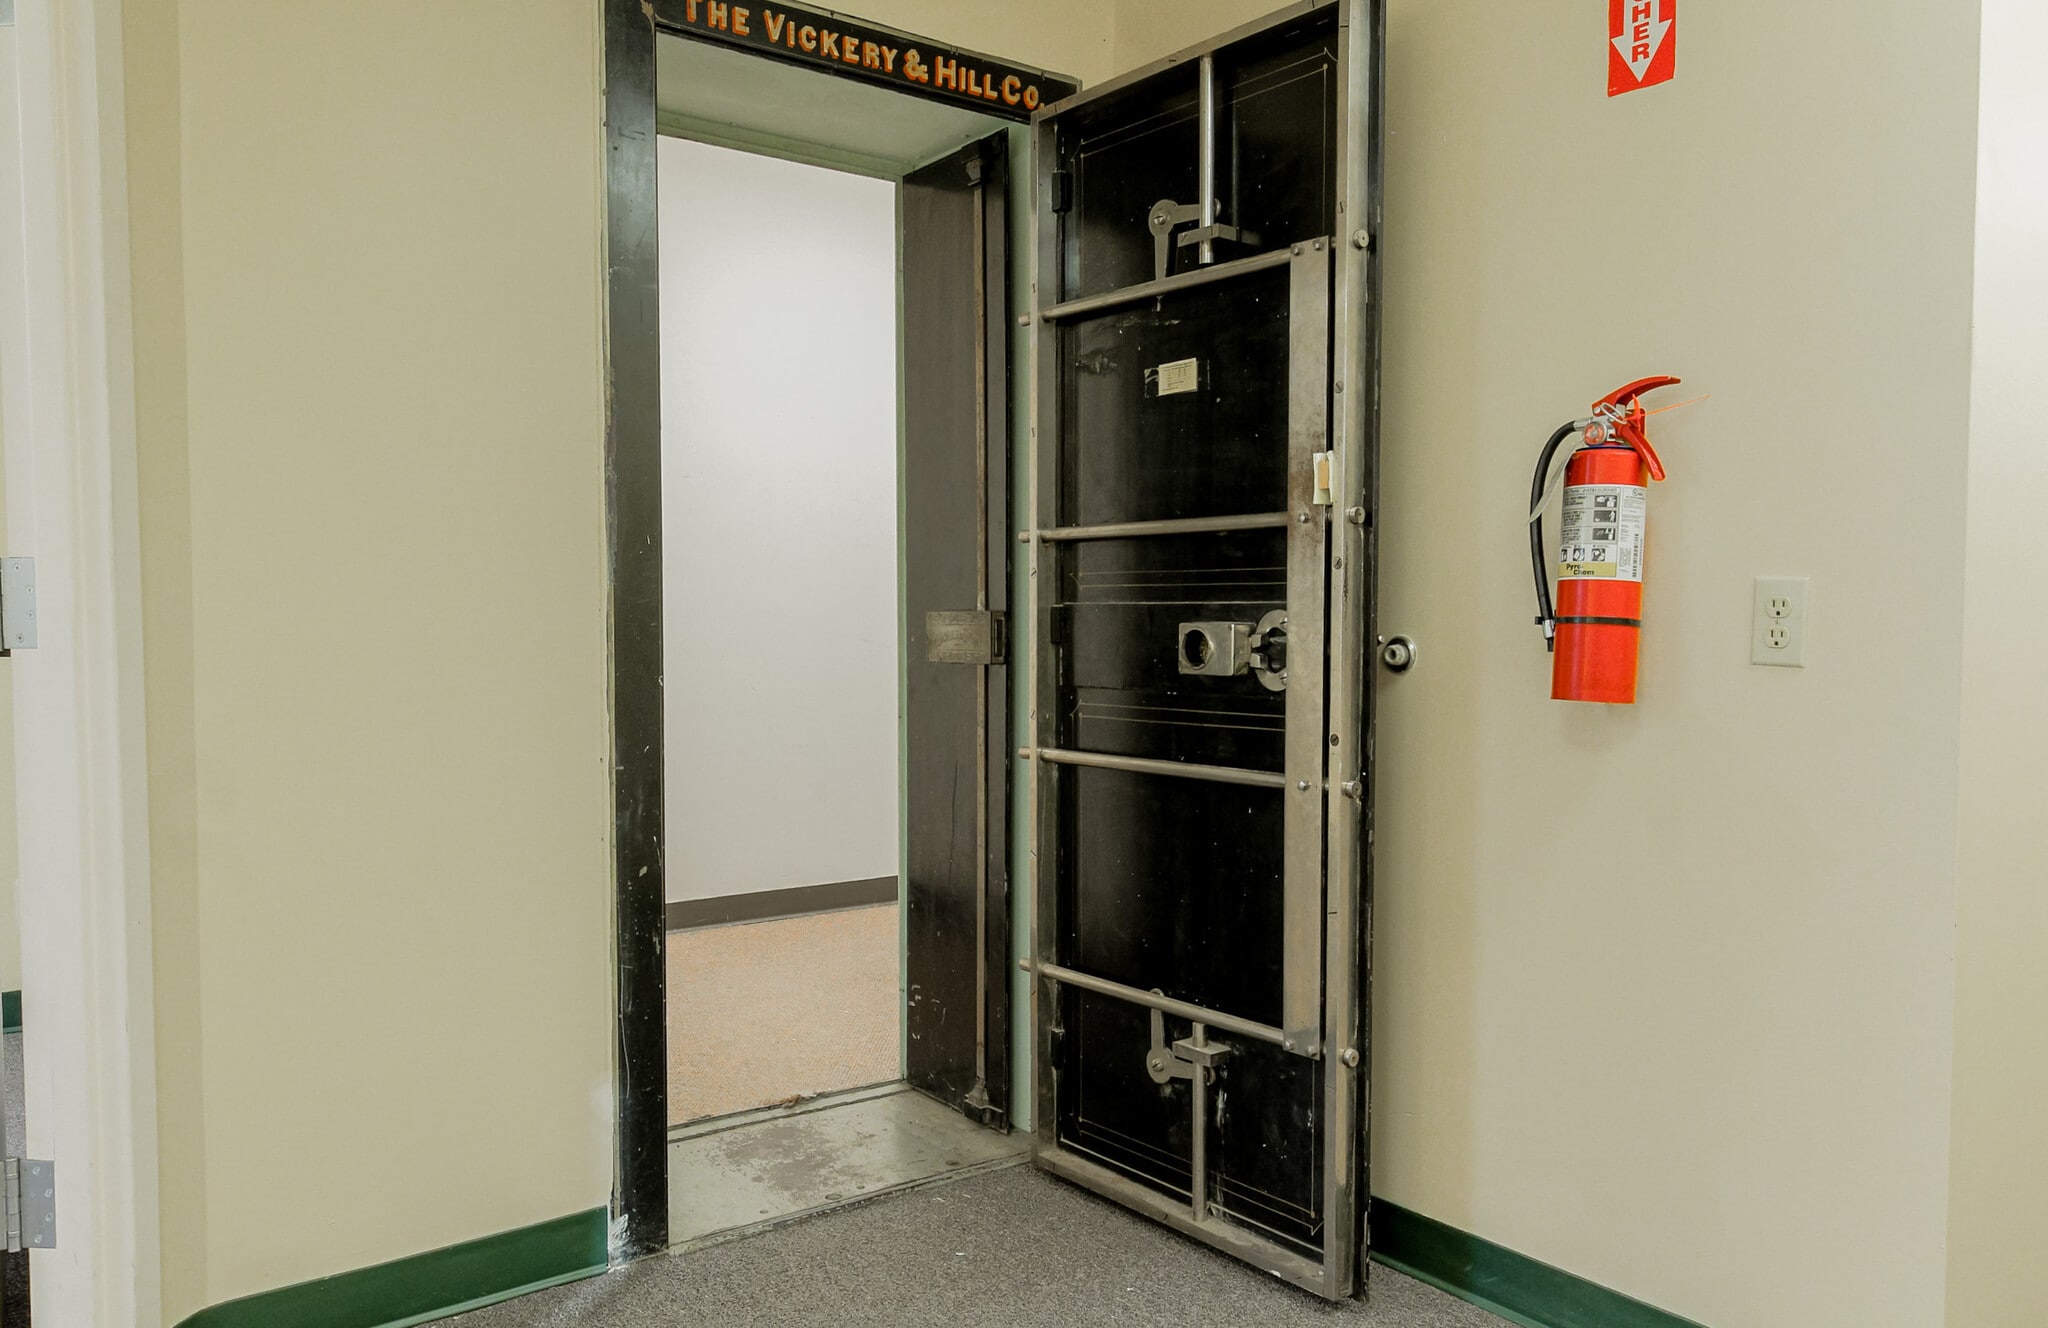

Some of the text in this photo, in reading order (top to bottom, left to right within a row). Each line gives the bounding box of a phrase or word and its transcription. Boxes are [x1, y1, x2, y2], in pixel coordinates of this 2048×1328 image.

[686, 0, 750, 36] THE
[763, 9, 898, 73] VICKERY
[903, 48, 929, 83] &
[935, 55, 998, 100] HILL
[1632, 0, 1651, 63] HER
